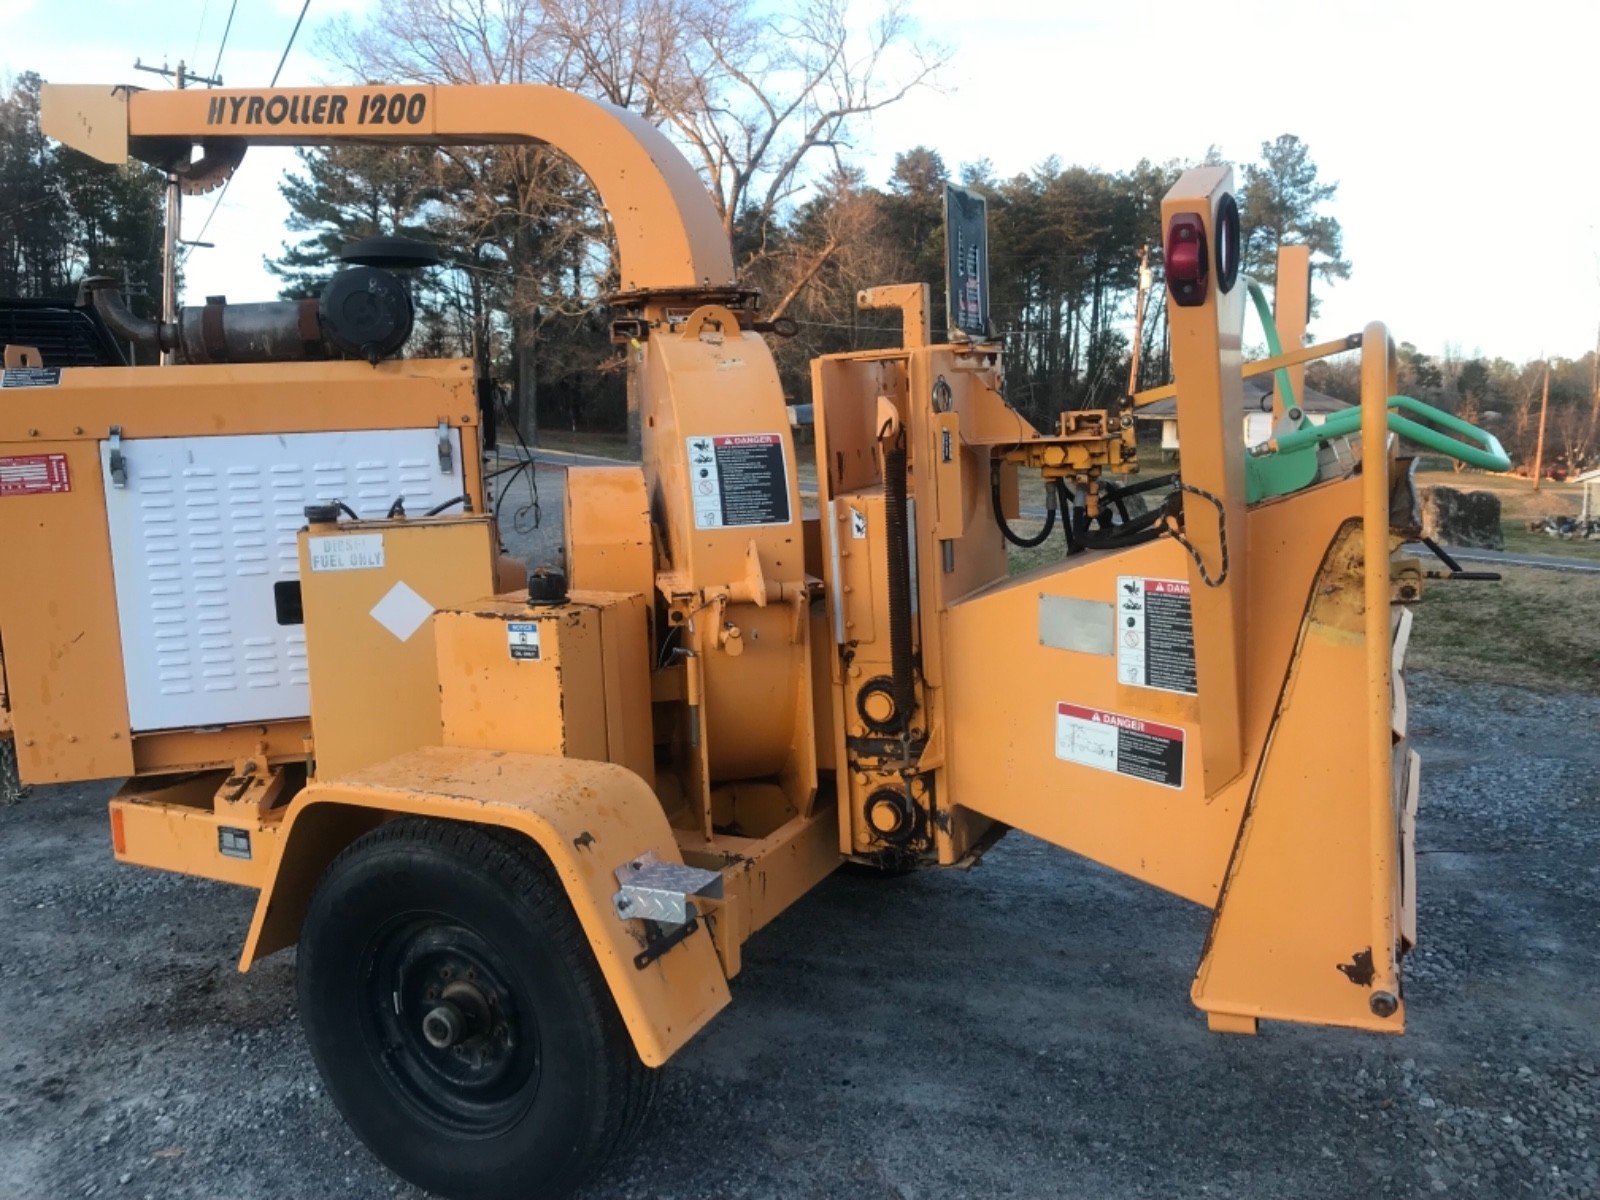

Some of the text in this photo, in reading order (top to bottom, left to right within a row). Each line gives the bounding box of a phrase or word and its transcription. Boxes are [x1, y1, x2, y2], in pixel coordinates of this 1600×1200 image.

[206, 93, 427, 125] HYROLLER 1200
[734, 436, 772, 445] DANGER
[313, 551, 381, 569] FUEL ONLY
[1166, 584, 1192, 594] DAN
[1103, 713, 1145, 732] DANGER
